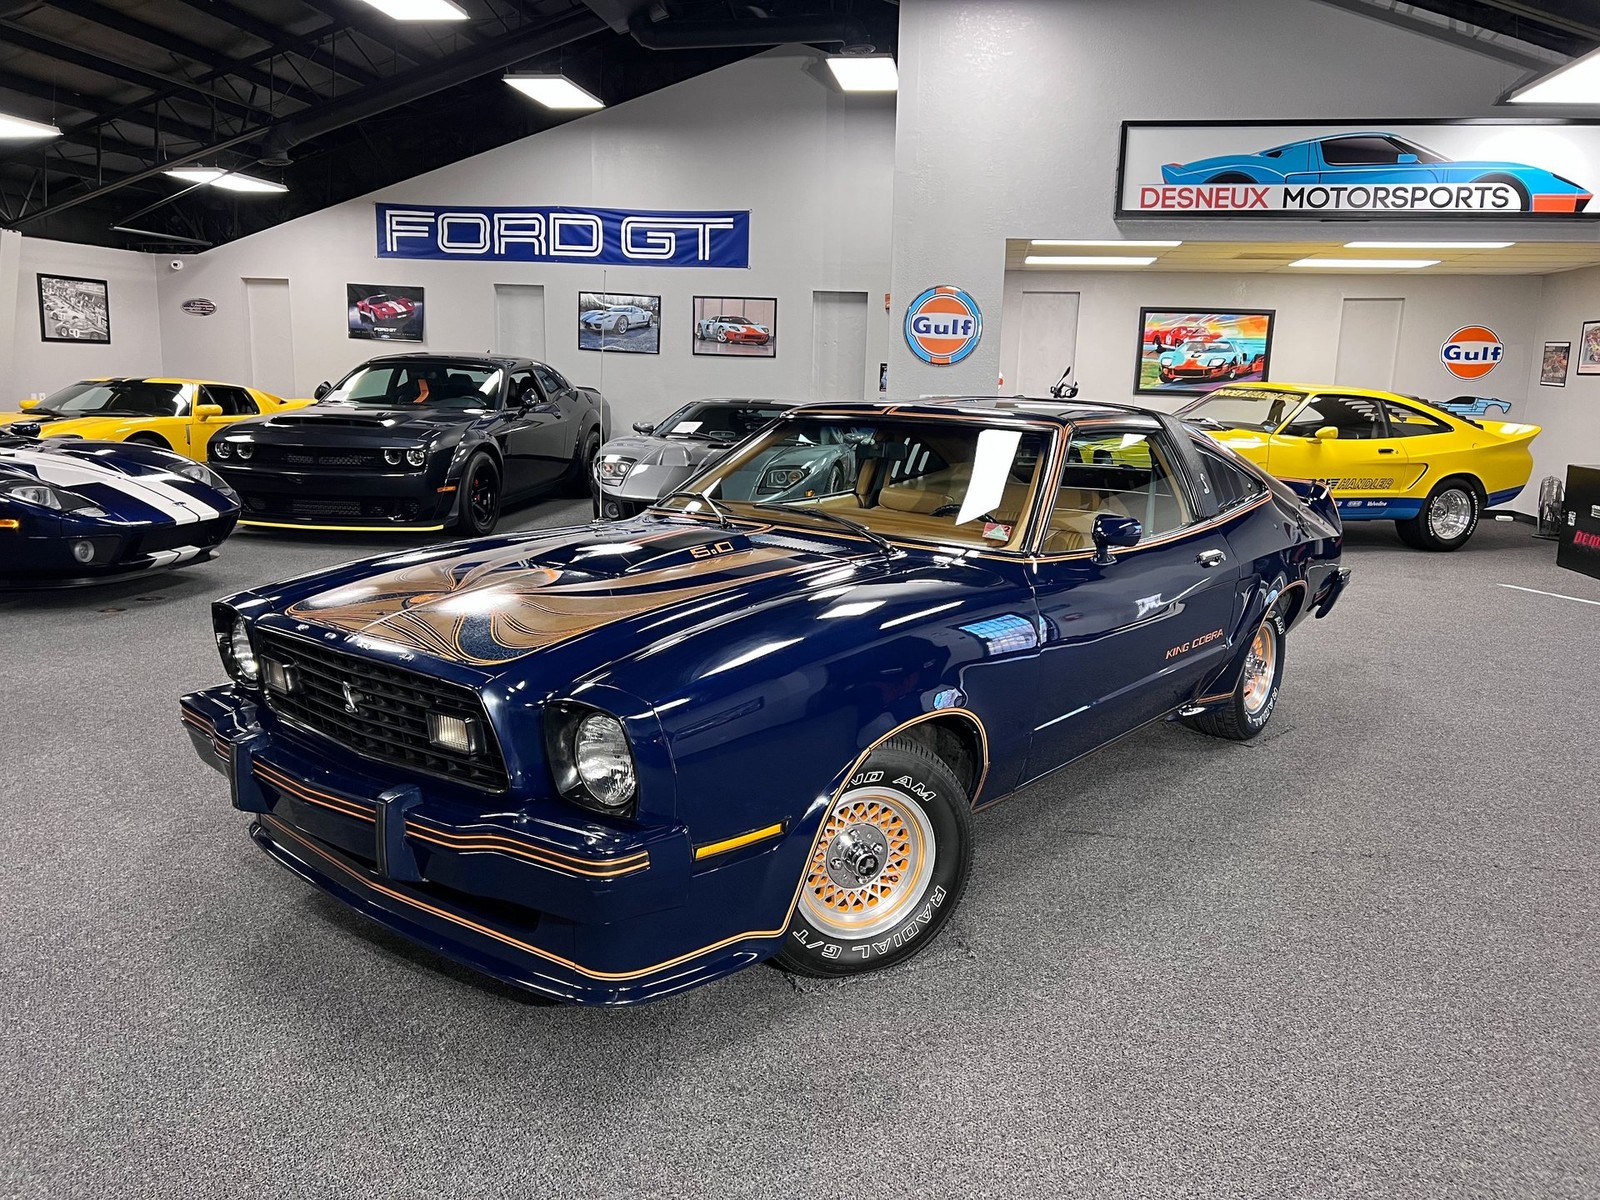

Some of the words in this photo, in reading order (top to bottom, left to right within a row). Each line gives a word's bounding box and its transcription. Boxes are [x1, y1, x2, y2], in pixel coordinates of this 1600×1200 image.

[1139, 186, 1270, 209] DESNEUX
[1282, 185, 1510, 209] MOTORSPORTS
[385, 209, 604, 257] FORD
[621, 216, 734, 261] GT
[913, 316, 972, 336] Gulf
[1443, 344, 1502, 361] Gulf
[1338, 478, 1395, 490] HANDLER
[690, 541, 734, 559] 5.0
[1165, 642, 1190, 660] KING
[1191, 628, 1224, 649] COBRA
[892, 775, 937, 802] AM
[852, 885, 946, 959] RADIAL
[793, 929, 843, 960] G/T
